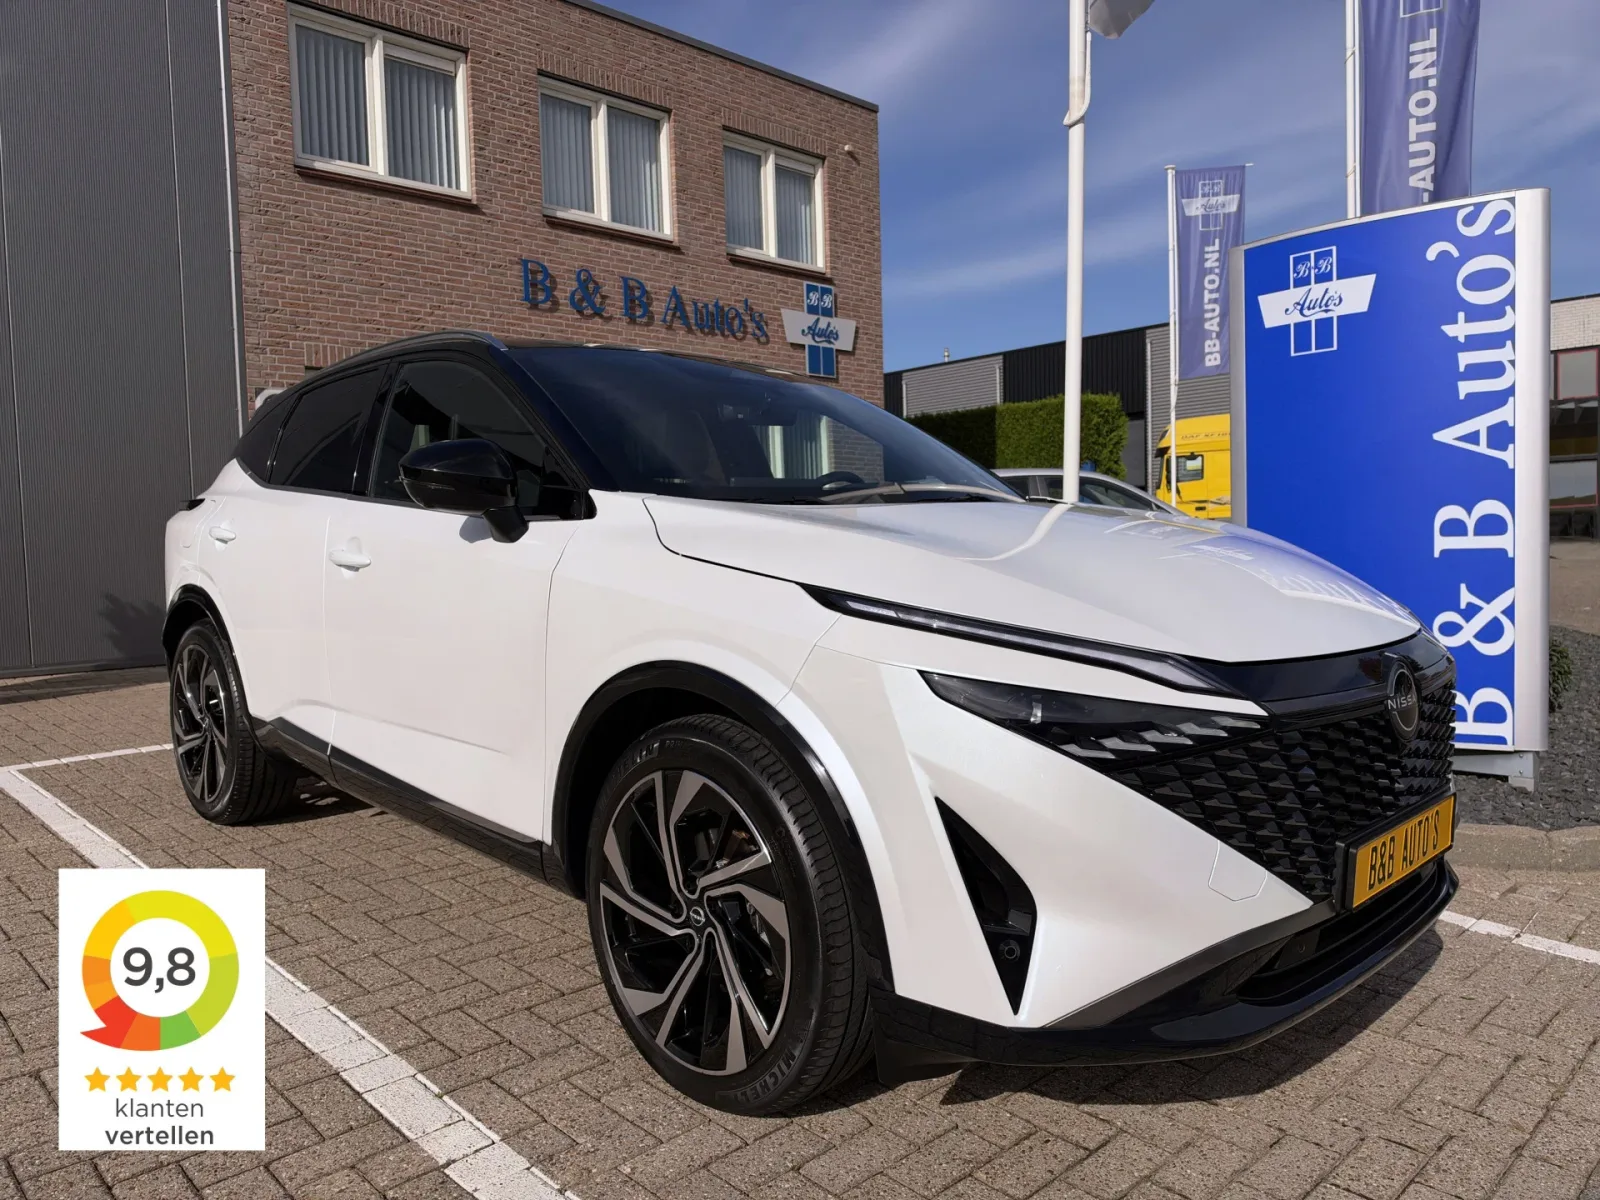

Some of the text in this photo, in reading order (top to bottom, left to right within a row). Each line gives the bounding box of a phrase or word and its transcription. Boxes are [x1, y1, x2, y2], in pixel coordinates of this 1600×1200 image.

[1408, 27, 1438, 203] -AUTO.NL
[520, 258, 767, 339] B & B Auto's
[801, 317, 840, 345] Auto's
[1203, 238, 1220, 367] BB-AUTO.NL
[1284, 287, 1344, 317] Auto's
[1426, 198, 1516, 747] B & B Auto's
[1387, 693, 1415, 711] NISS
[1368, 809, 1440, 891] B&B AUTO'S
